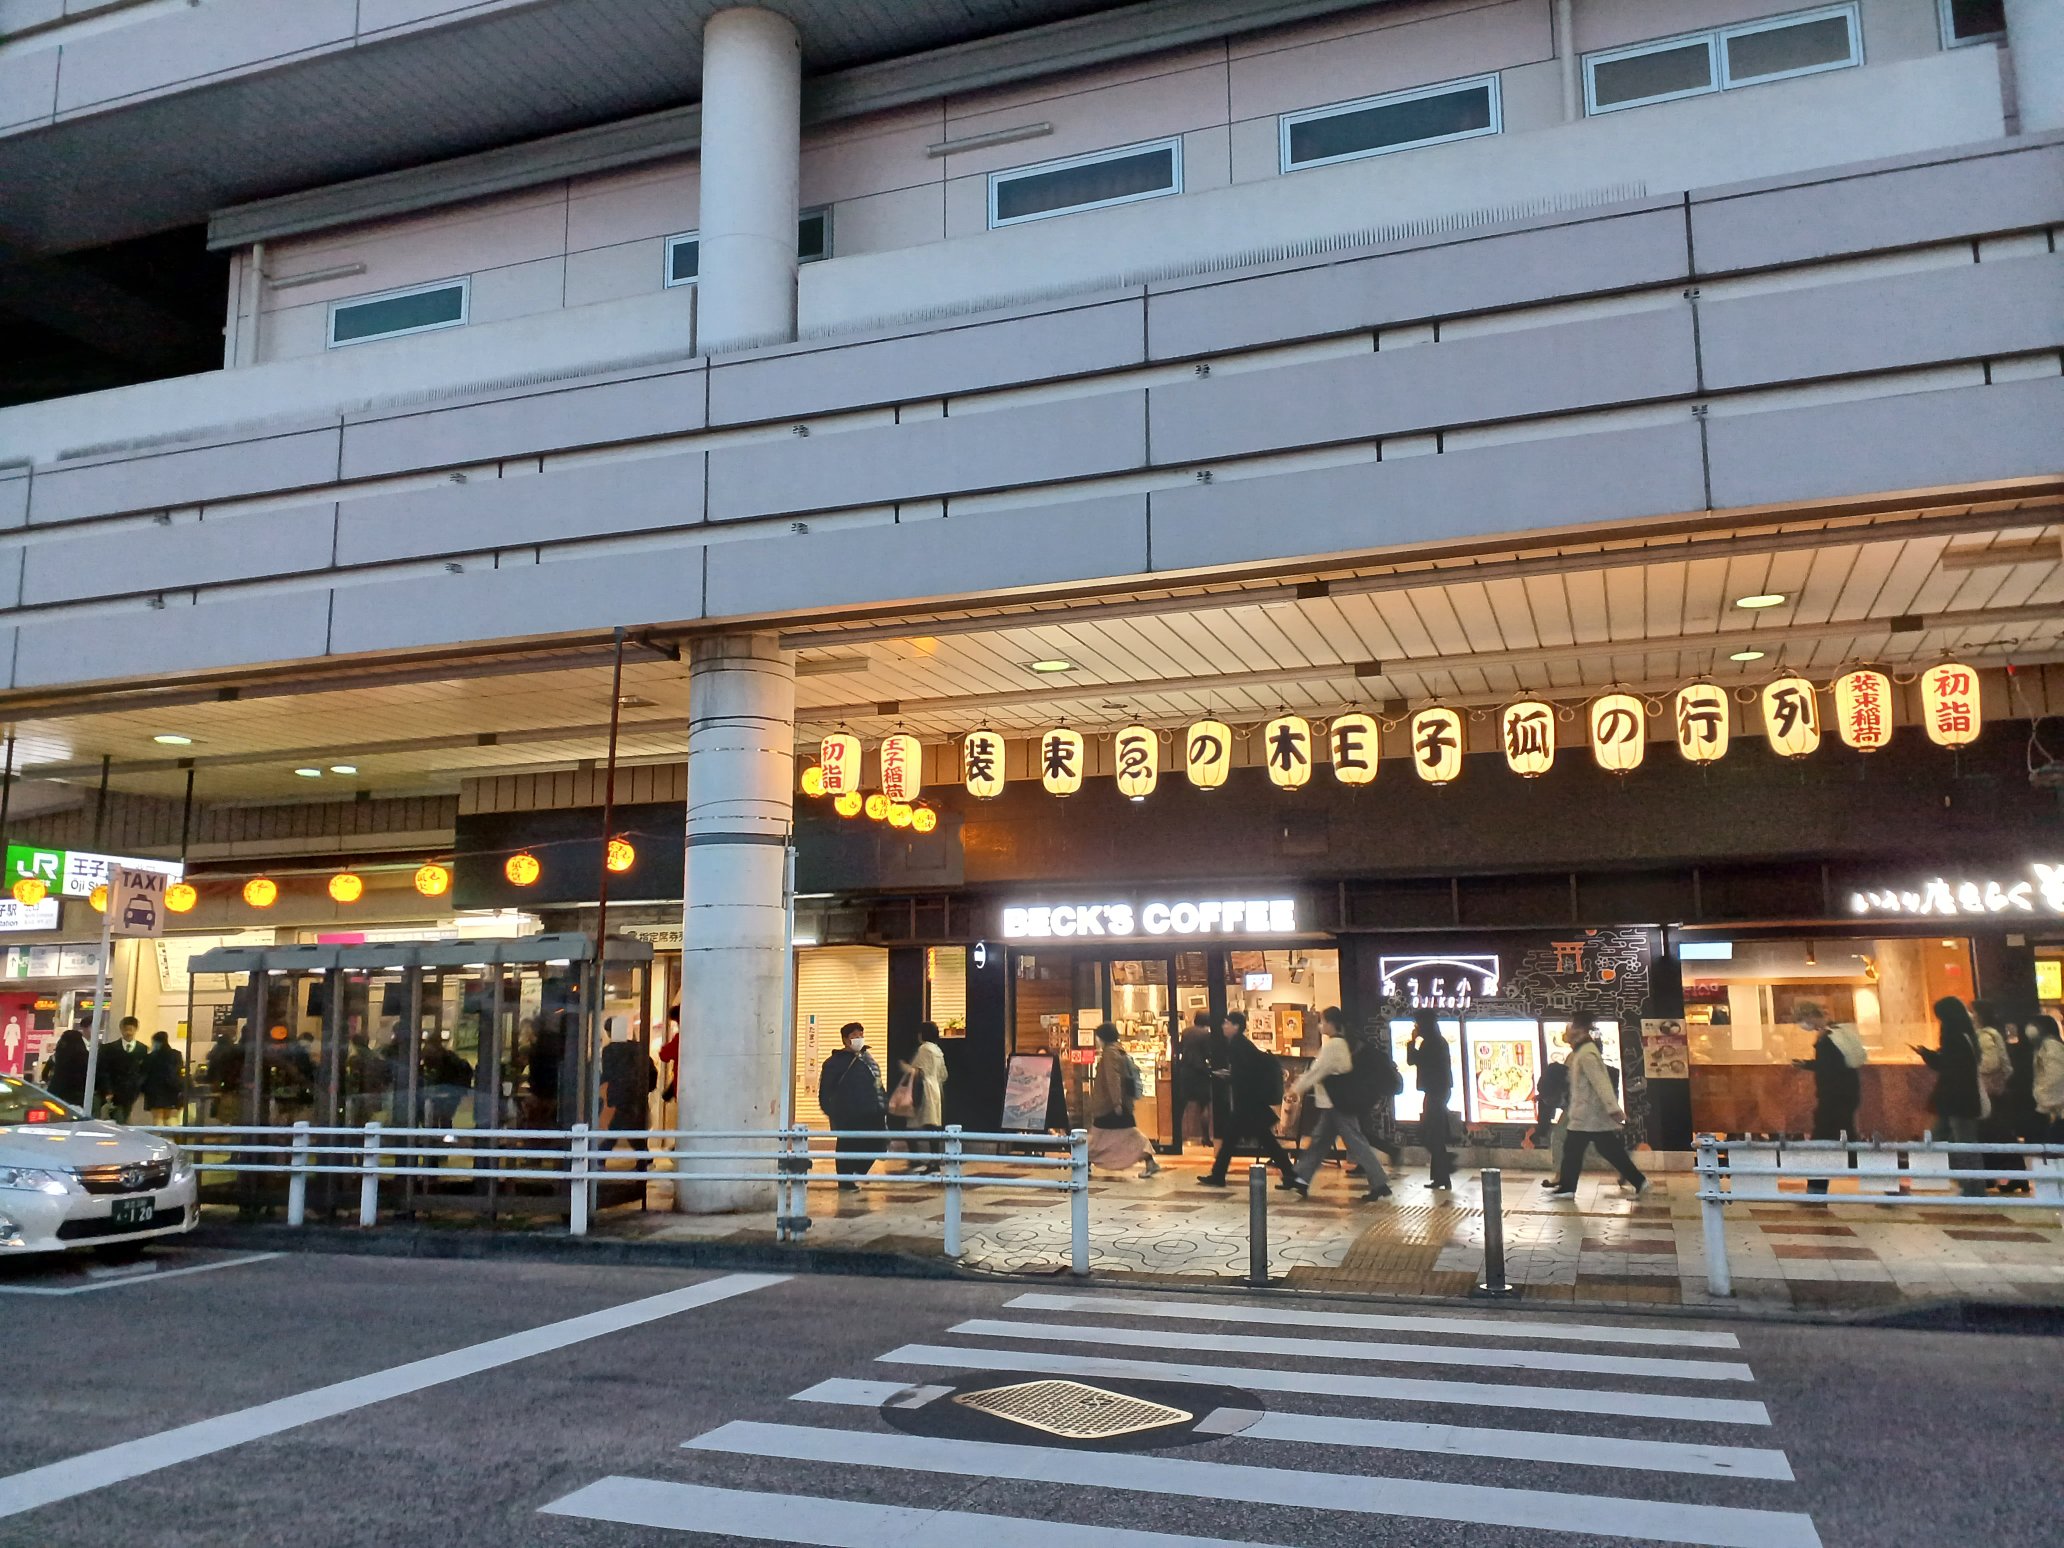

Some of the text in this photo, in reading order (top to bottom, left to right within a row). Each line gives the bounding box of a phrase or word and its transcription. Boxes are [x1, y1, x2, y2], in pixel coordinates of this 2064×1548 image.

[1850, 674, 1882, 743] 装束稲荷
[1933, 670, 1971, 733] 初詣
[965, 738, 995, 782] 装
[1189, 734, 1223, 765] の
[1268, 725, 1307, 771] 木
[1332, 725, 1368, 770] 王
[1416, 718, 1457, 767] 子
[1507, 711, 1550, 759] 狐
[1597, 708, 1639, 744] の
[1679, 696, 1723, 745] 行
[1771, 687, 1818, 738] 列
[822, 740, 845, 789] 初詣
[883, 738, 905, 799] 王子稲荷
[17, 852, 59, 880] JR
[122, 871, 165, 892] TAXI
[1003, 899, 1297, 938] BECK'S COFFEE
